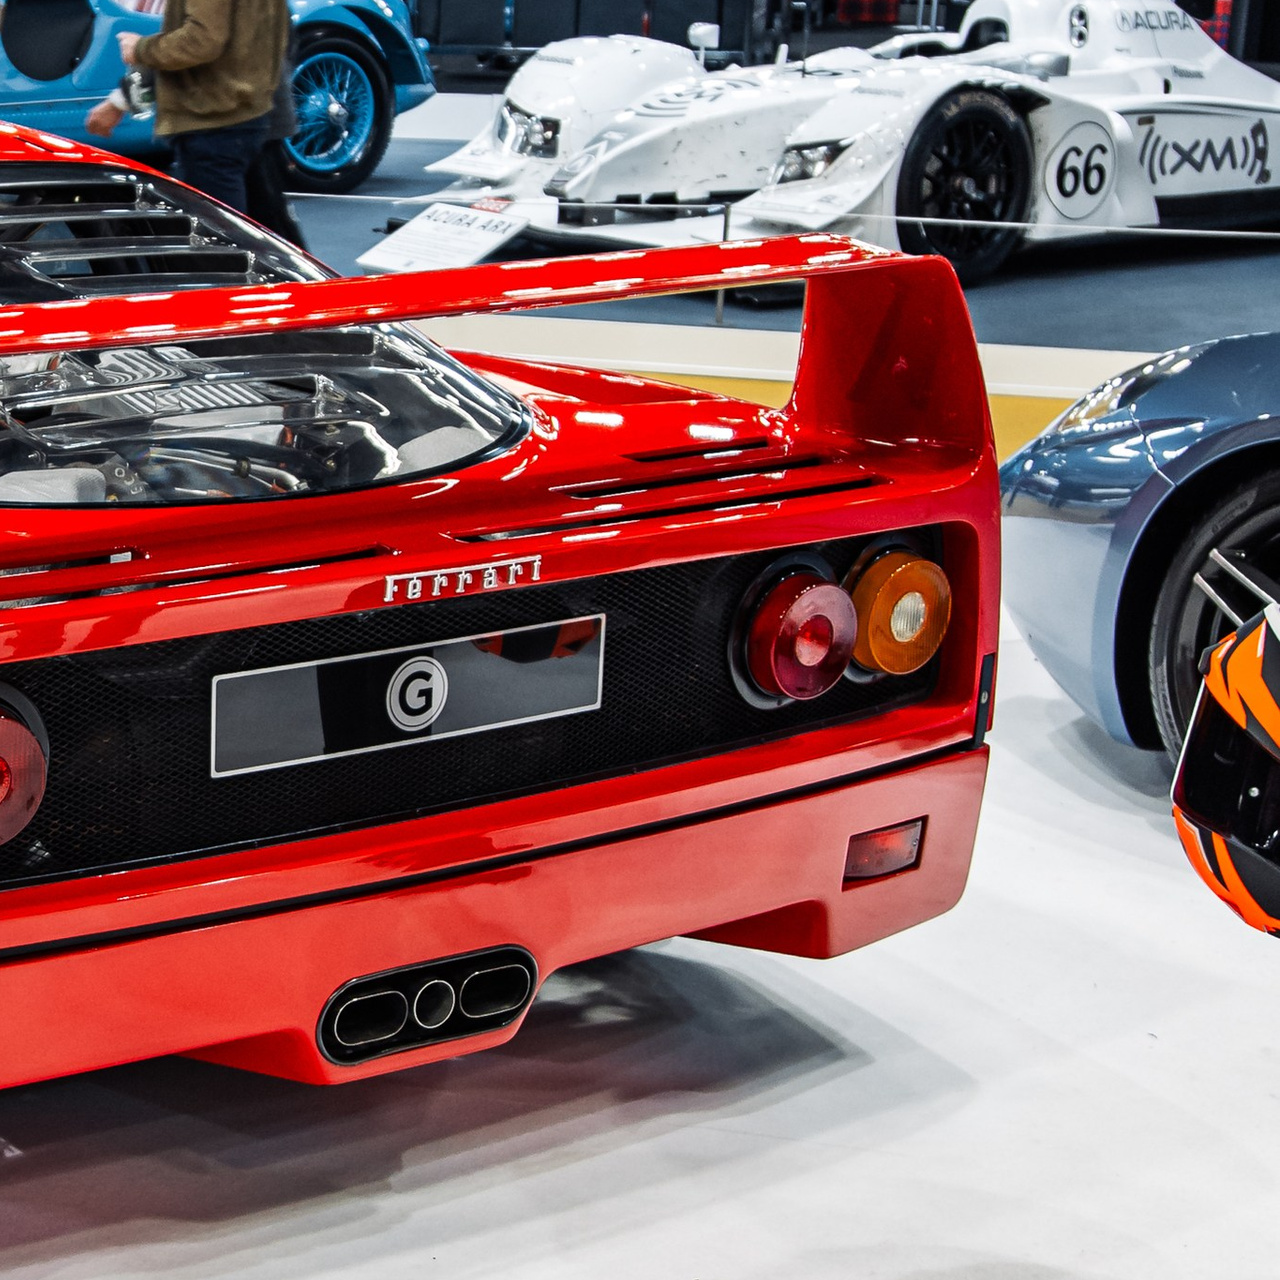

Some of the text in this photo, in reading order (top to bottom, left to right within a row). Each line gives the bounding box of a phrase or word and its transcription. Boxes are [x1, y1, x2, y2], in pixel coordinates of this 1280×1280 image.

[1132, 10, 1195, 31] ACURA
[1055, 144, 1108, 198] 66
[425, 209, 517, 235] ACURA ARX
[383, 554, 542, 602] Ferrari
[398, 670, 434, 717] G
